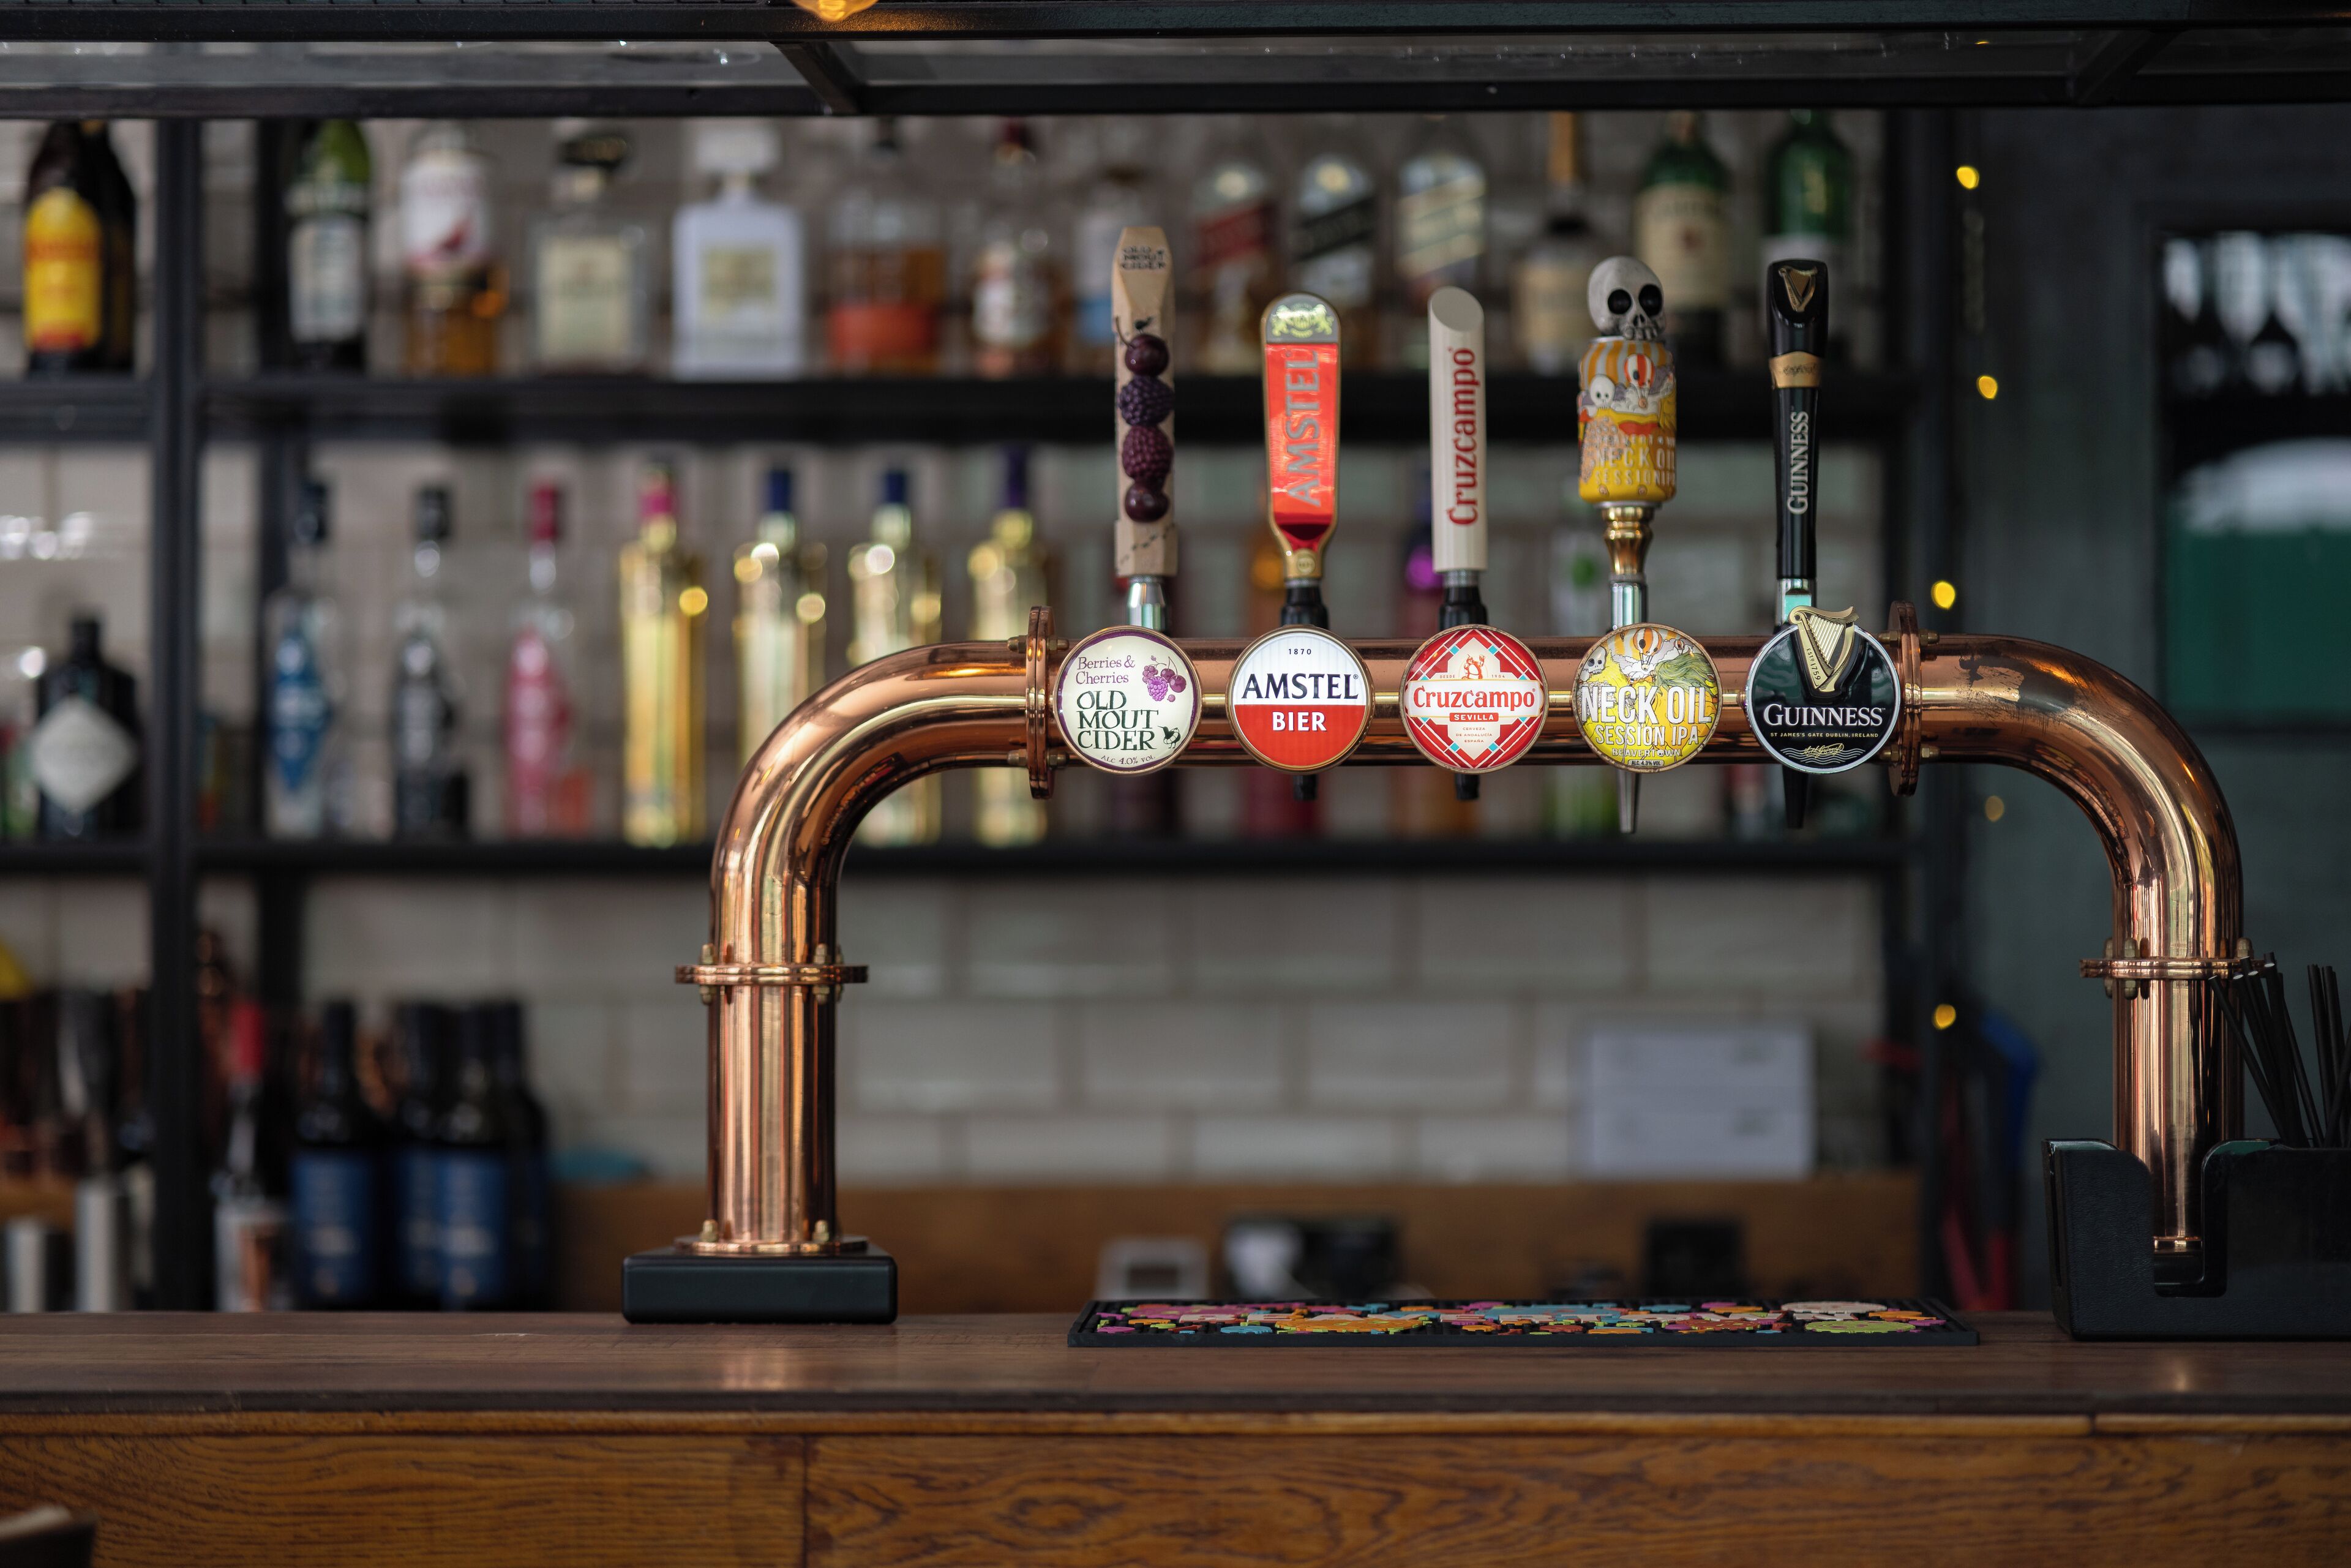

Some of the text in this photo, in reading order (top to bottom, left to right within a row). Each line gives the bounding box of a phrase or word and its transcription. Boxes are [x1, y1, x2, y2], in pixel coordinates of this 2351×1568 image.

[1286, 350, 1321, 507] AMSTEL
[1447, 348, 1480, 526] Cruzcampo
[1596, 446, 1651, 468] NECK
[1787, 411, 1809, 514] GUINNESS
[1595, 468, 1660, 486] SESSION
[1077, 655, 1135, 670] Berries &
[1810, 663, 1821, 680] 1759
[1076, 672, 1129, 685] Cherries
[1241, 673, 1359, 699] AMSTEL
[1076, 690, 1127, 710] OLD
[1413, 685, 1535, 711] Cruzcampo
[1581, 686, 1712, 724] NECK OIL
[1076, 710, 1158, 729] MOUT
[1272, 711, 1327, 732] BIER
[1763, 703, 1883, 726] GUINNESS
[1078, 730, 1157, 751] CIDER
[1595, 724, 1699, 746] SESSION IPA
[1101, 755, 1116, 763] ALC
[1119, 756, 1139, 765] 4.0%
